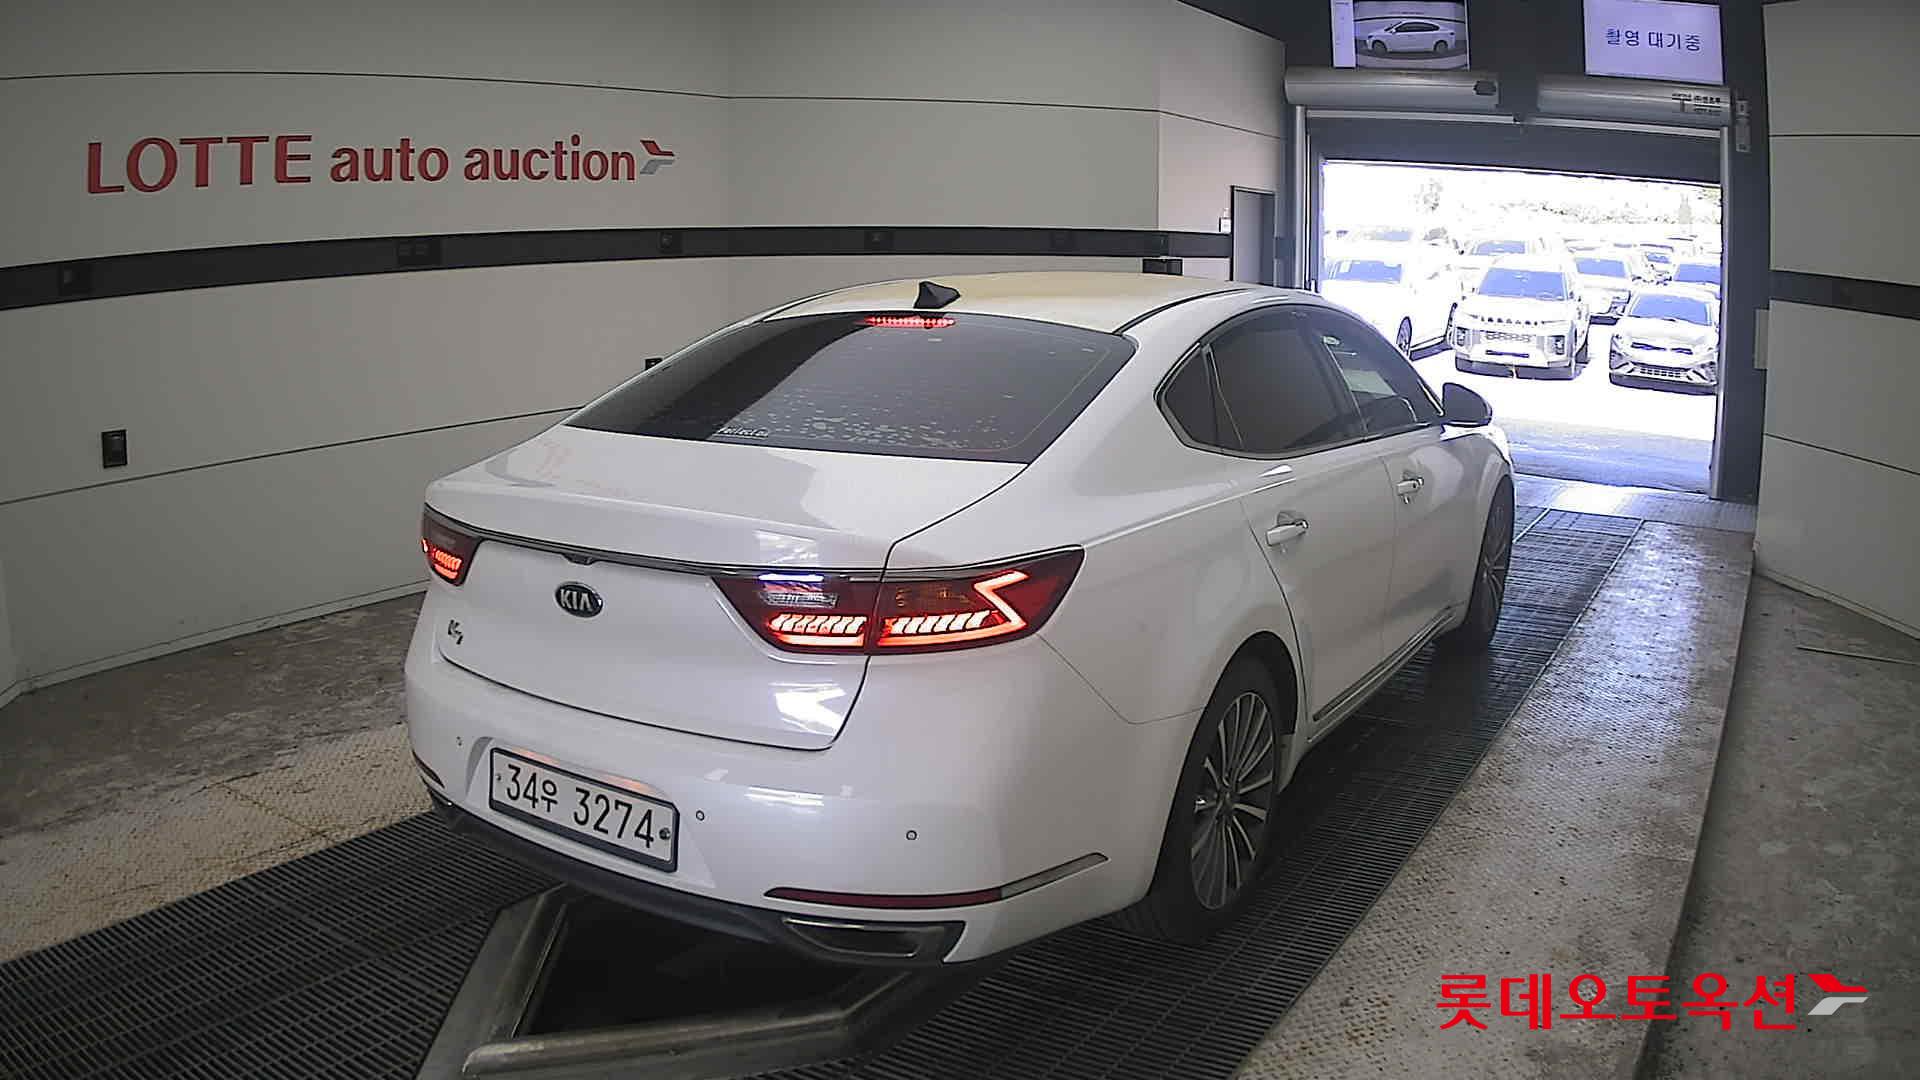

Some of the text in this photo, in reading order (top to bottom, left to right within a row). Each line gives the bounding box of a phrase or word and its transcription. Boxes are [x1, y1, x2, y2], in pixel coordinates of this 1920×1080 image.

[1647, 31, 1701, 52] 대기중
[86, 133, 636, 194] LOTTE auto auction
[560, 588, 592, 611] KIA
[506, 763, 655, 849] 34우 3274
